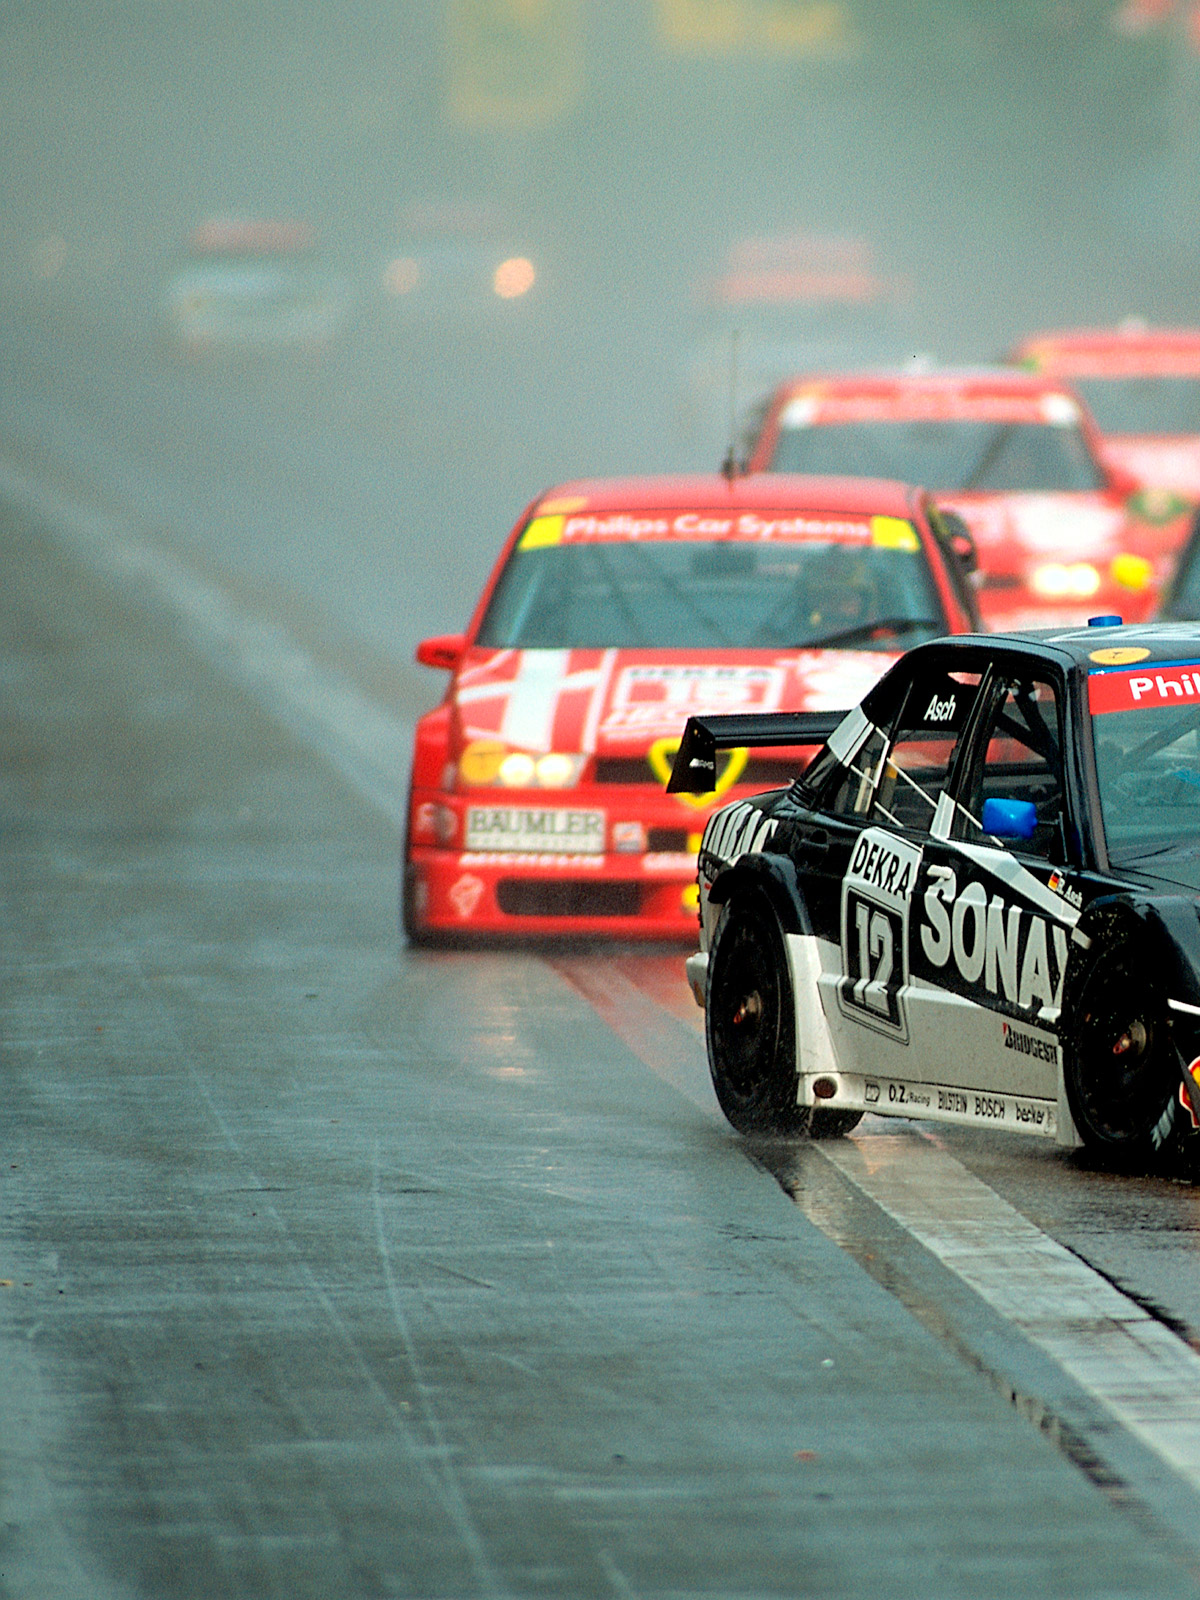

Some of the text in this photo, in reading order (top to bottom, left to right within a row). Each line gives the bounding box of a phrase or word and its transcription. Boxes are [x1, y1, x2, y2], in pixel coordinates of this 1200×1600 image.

[564, 514, 870, 539] Philips Car Systems
[923, 694, 956, 721] Asch
[851, 838, 911, 900] DEKRA
[855, 900, 893, 1017] 12
[975, 1097, 1005, 1119] BOSCH
[1016, 1102, 1044, 1124] becker
